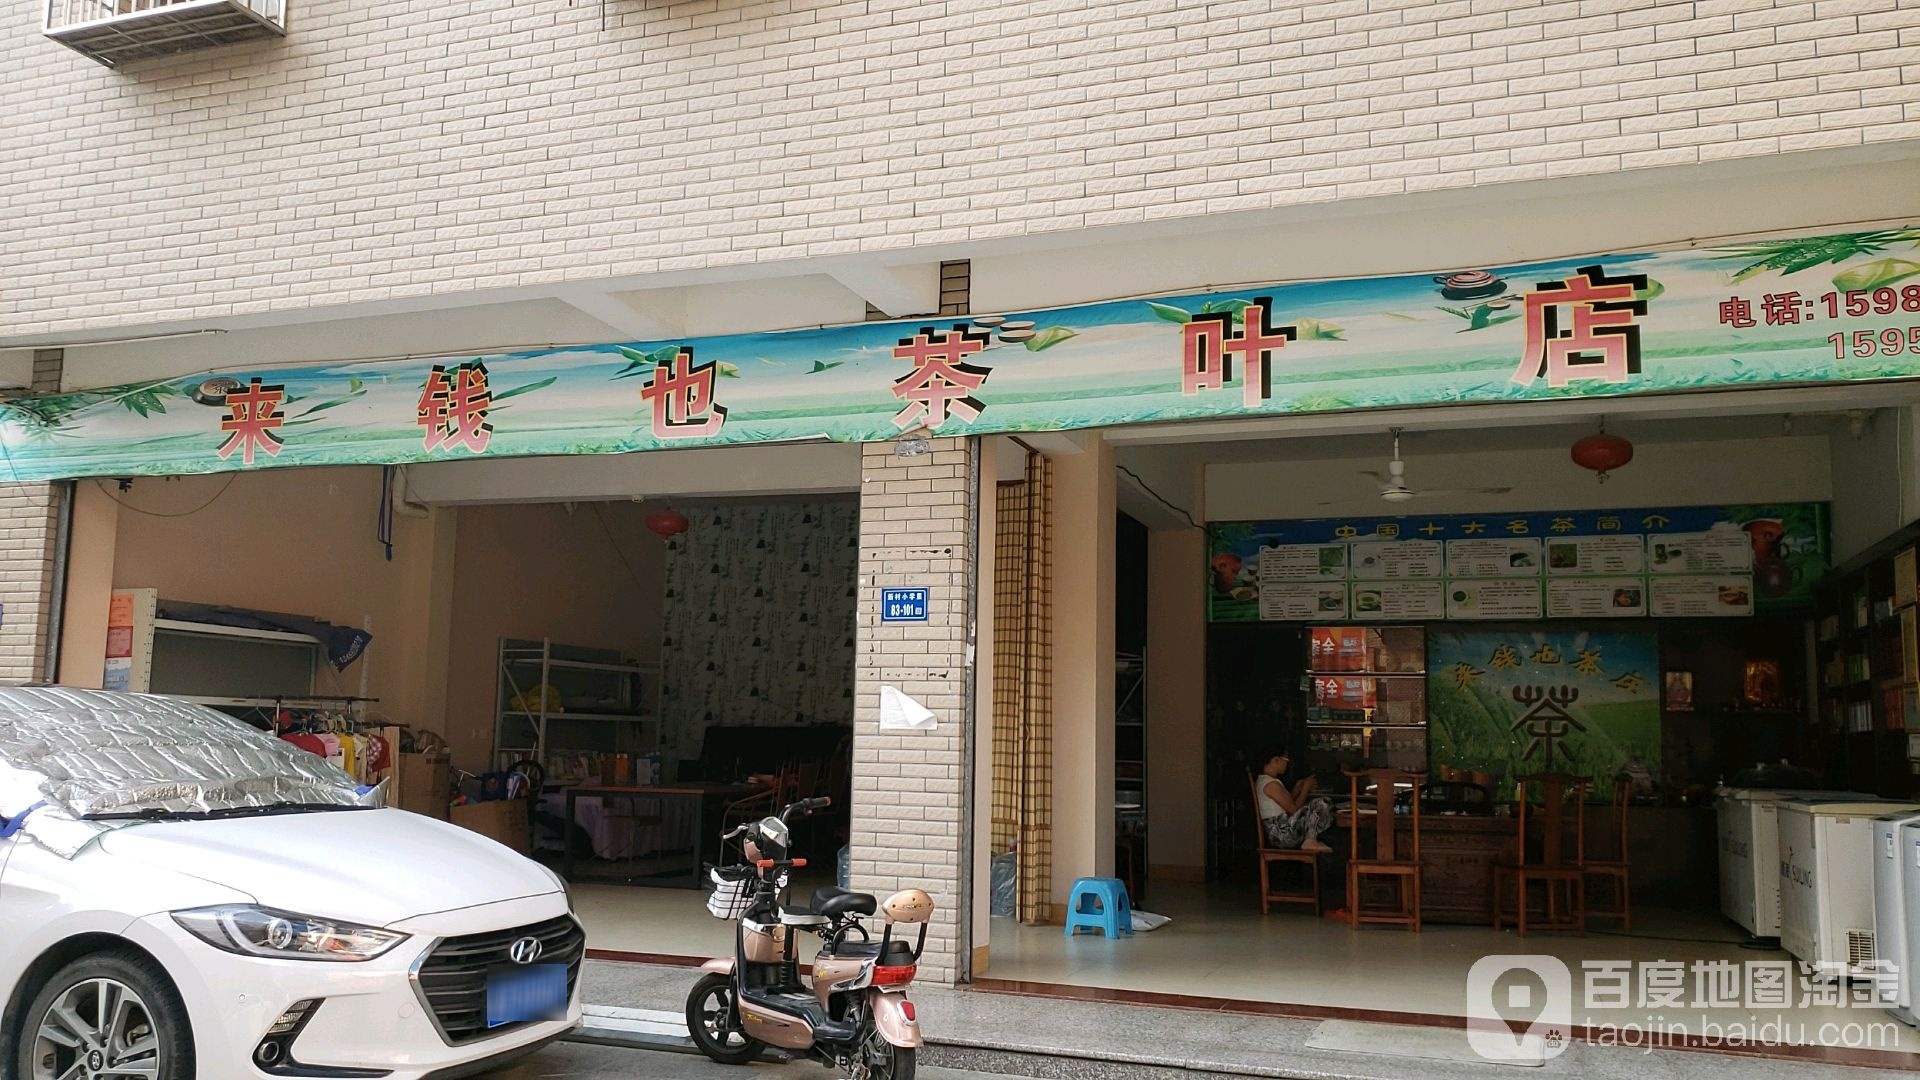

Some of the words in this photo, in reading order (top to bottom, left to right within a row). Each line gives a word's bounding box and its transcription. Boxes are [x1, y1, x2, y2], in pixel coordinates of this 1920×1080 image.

[217, 265, 1648, 465] 来钱也茶叶店
[1334, 514, 1670, 539] 中国十大名茶简介
